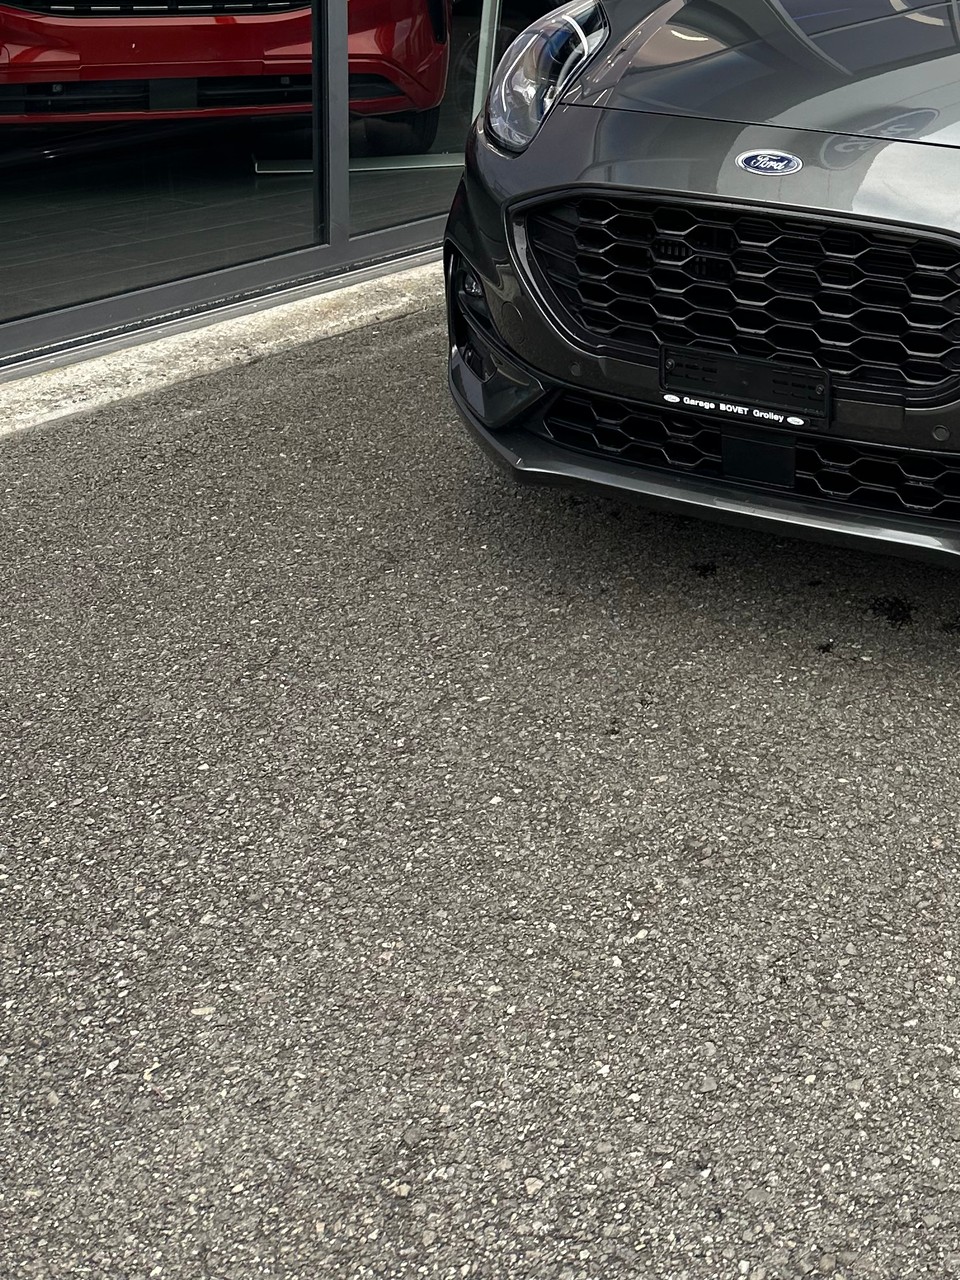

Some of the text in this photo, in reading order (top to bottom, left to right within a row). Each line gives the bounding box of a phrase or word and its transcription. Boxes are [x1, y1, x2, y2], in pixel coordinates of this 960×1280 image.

[751, 154, 788, 170] Ford
[683, 396, 715, 410] Garage
[719, 402, 749, 415] BOVET
[752, 409, 784, 423] Grolley
